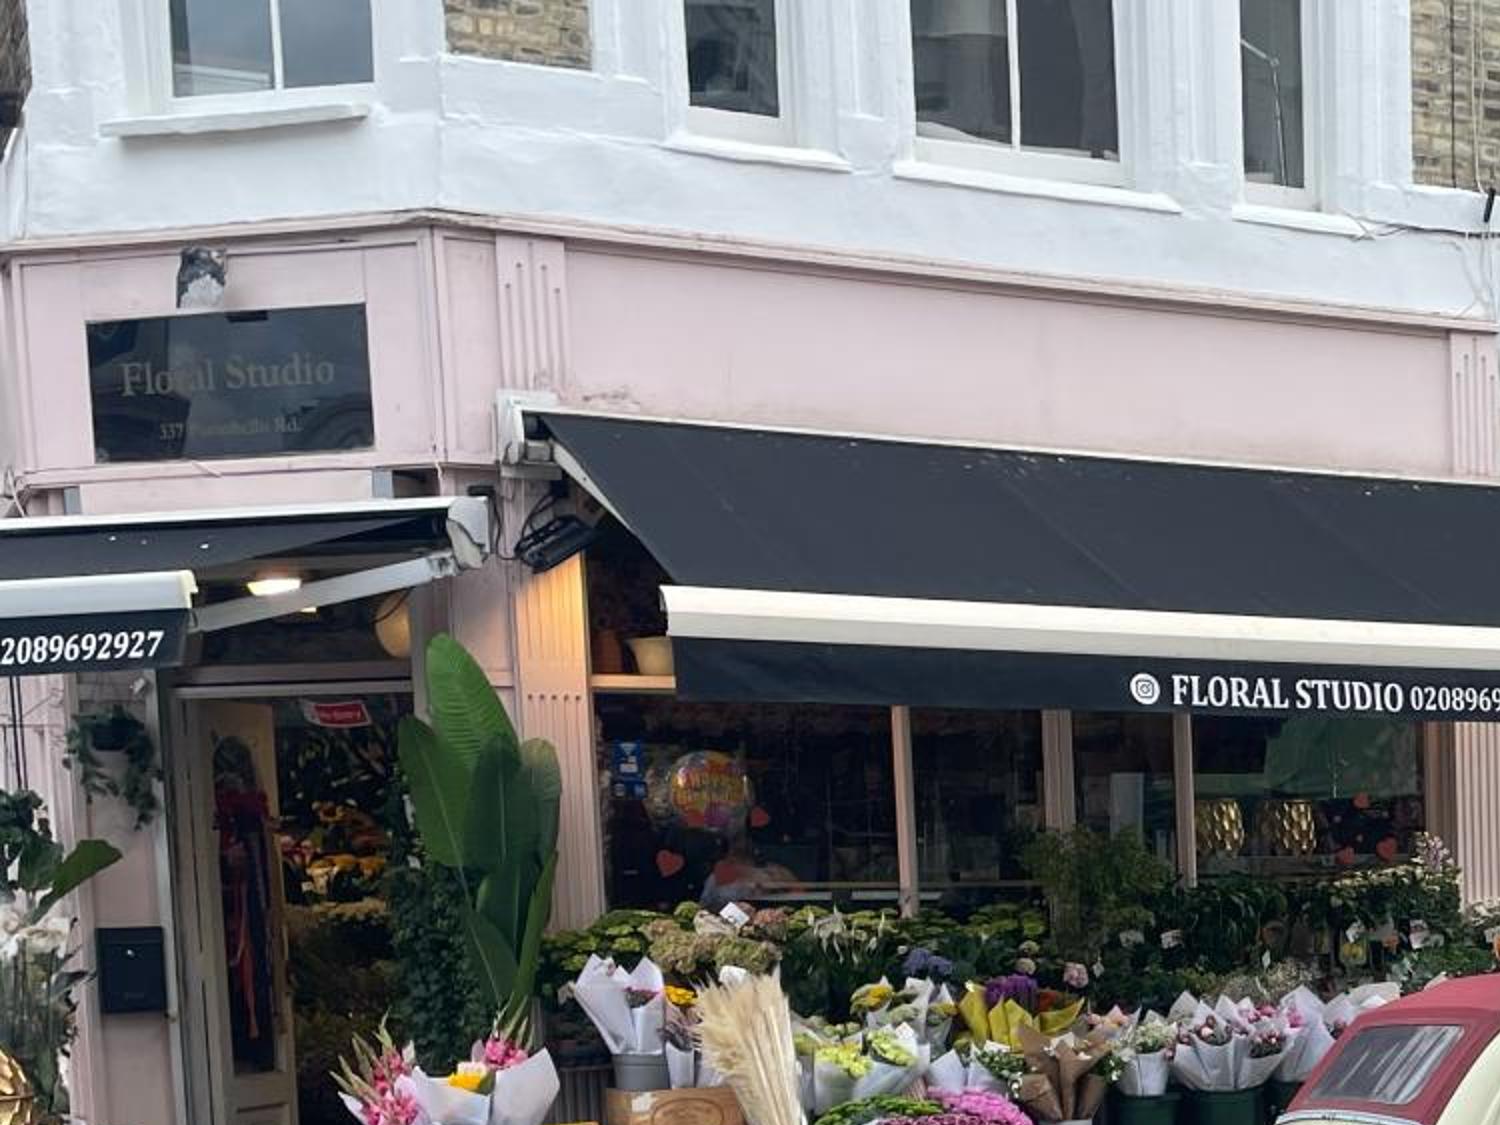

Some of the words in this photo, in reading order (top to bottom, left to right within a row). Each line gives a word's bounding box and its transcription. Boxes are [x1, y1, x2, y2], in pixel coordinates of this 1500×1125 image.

[224, 352, 336, 391] Studio
[0, 630, 165, 665] 2089692927
[1172, 673, 1289, 710] FLORAL
[1295, 678, 1404, 713] STUDIO
